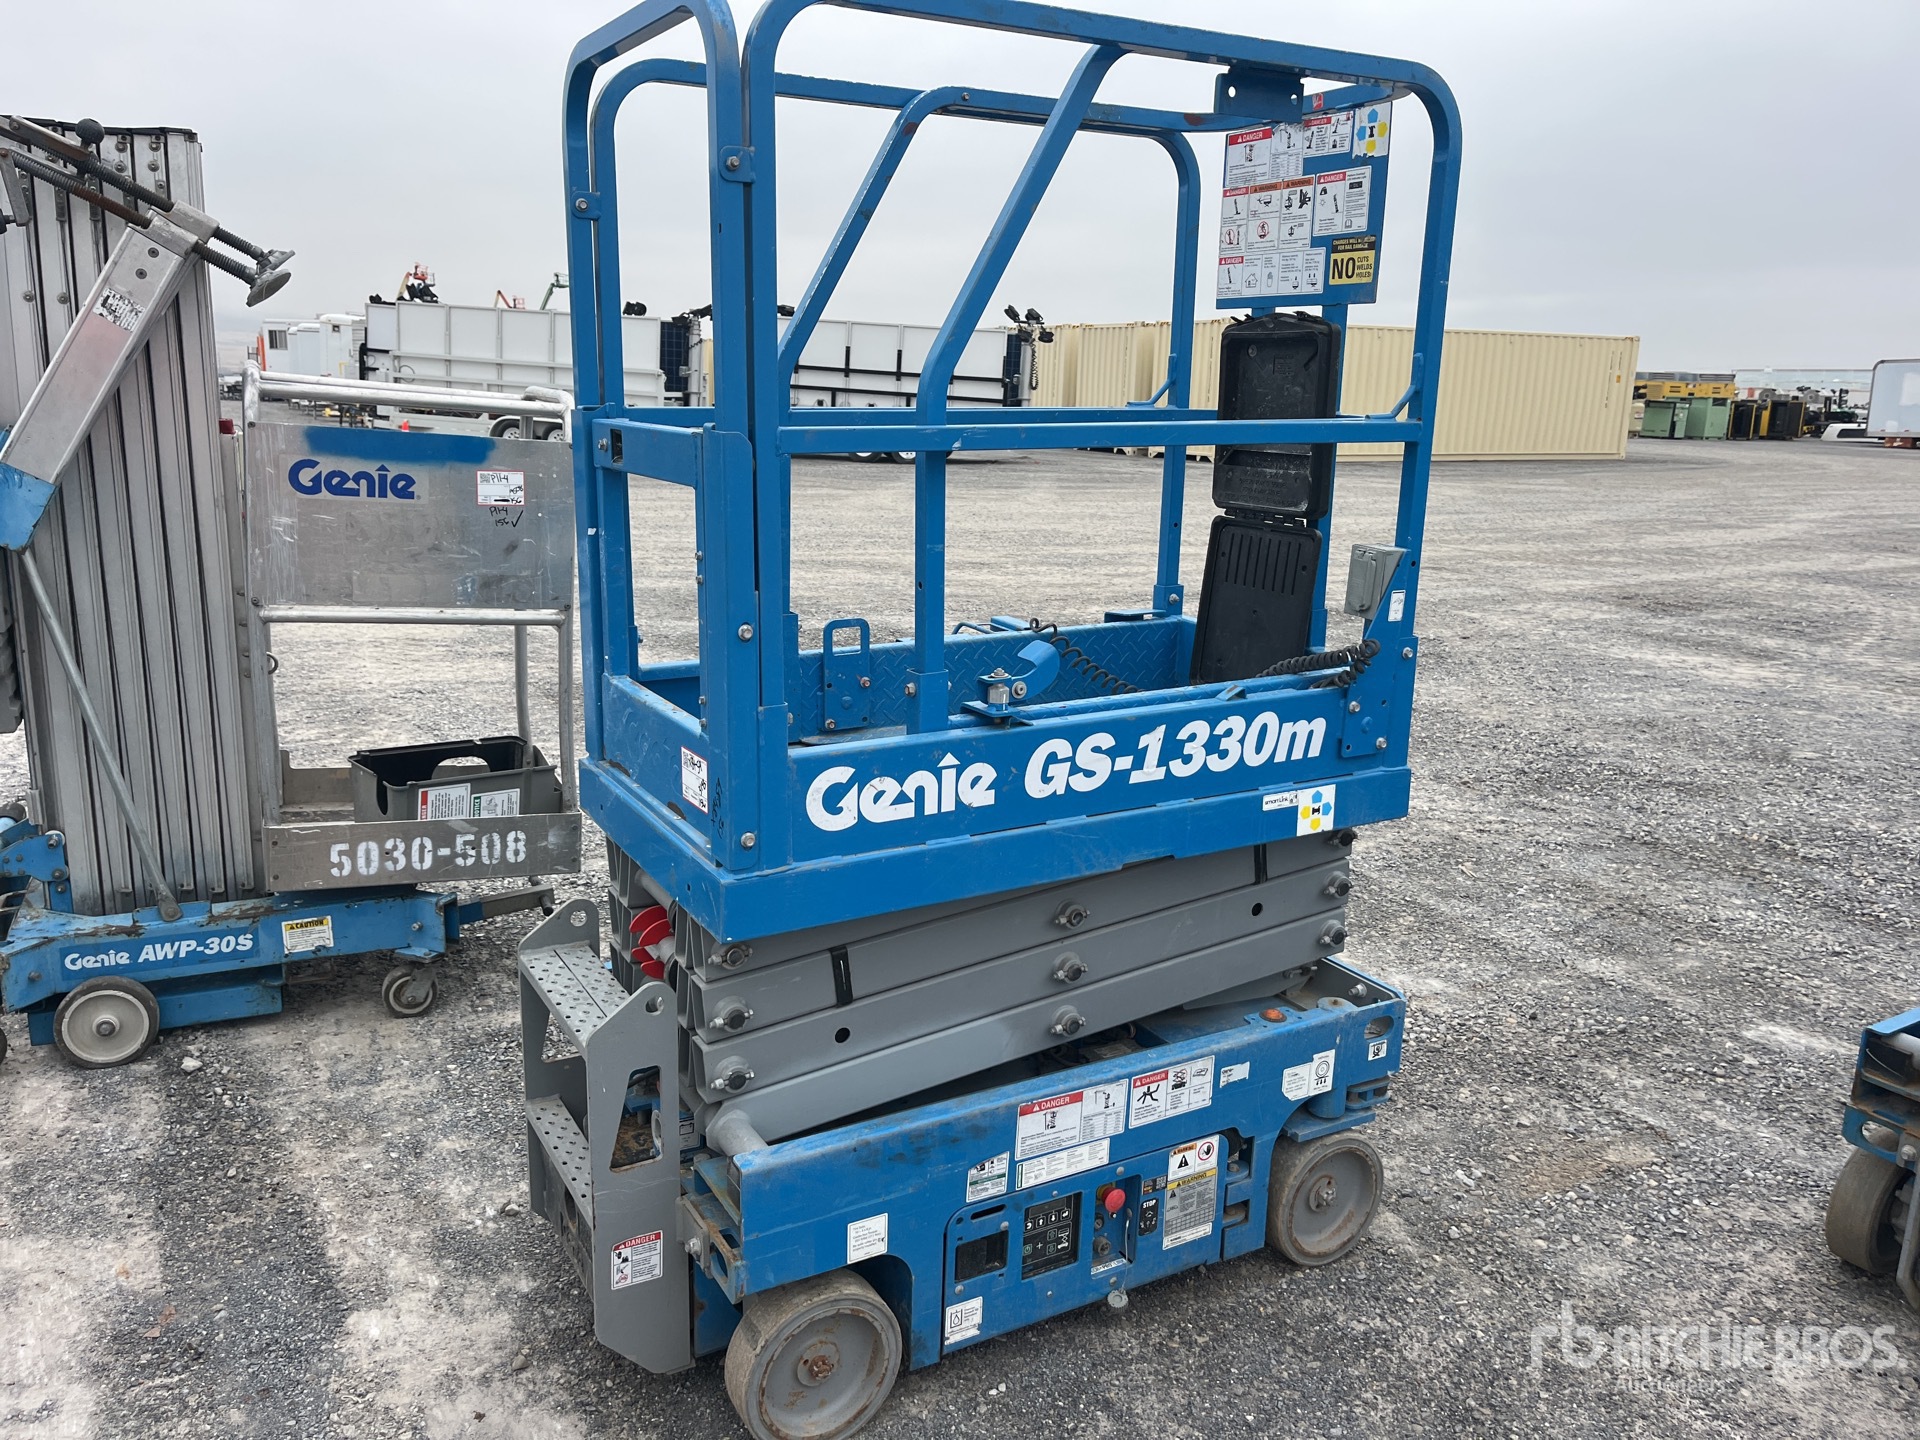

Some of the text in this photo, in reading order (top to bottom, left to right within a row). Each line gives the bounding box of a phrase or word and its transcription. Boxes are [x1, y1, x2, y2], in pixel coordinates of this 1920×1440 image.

[1243, 132, 1263, 142] DANGER
[1324, 173, 1344, 182] DANGER
[1230, 188, 1247, 196] DANGER
[1331, 257, 1356, 280] NO
[1356, 263, 1373, 271] WELDS
[288, 459, 416, 499] Genie
[805, 752, 998, 832] Genie
[1023, 711, 1327, 798] GS-1330m
[330, 830, 527, 877] 5030-508
[295, 919, 324, 929] CAUTION
[64, 933, 254, 971] Genie AWP-30S
[1142, 1073, 1166, 1085] DANGER
[1041, 1096, 1070, 1110] DANGER
[1181, 1172, 1207, 1186] WARNING
[1142, 1199, 1157, 1209] STOP
[625, 1234, 656, 1247] DANGER
